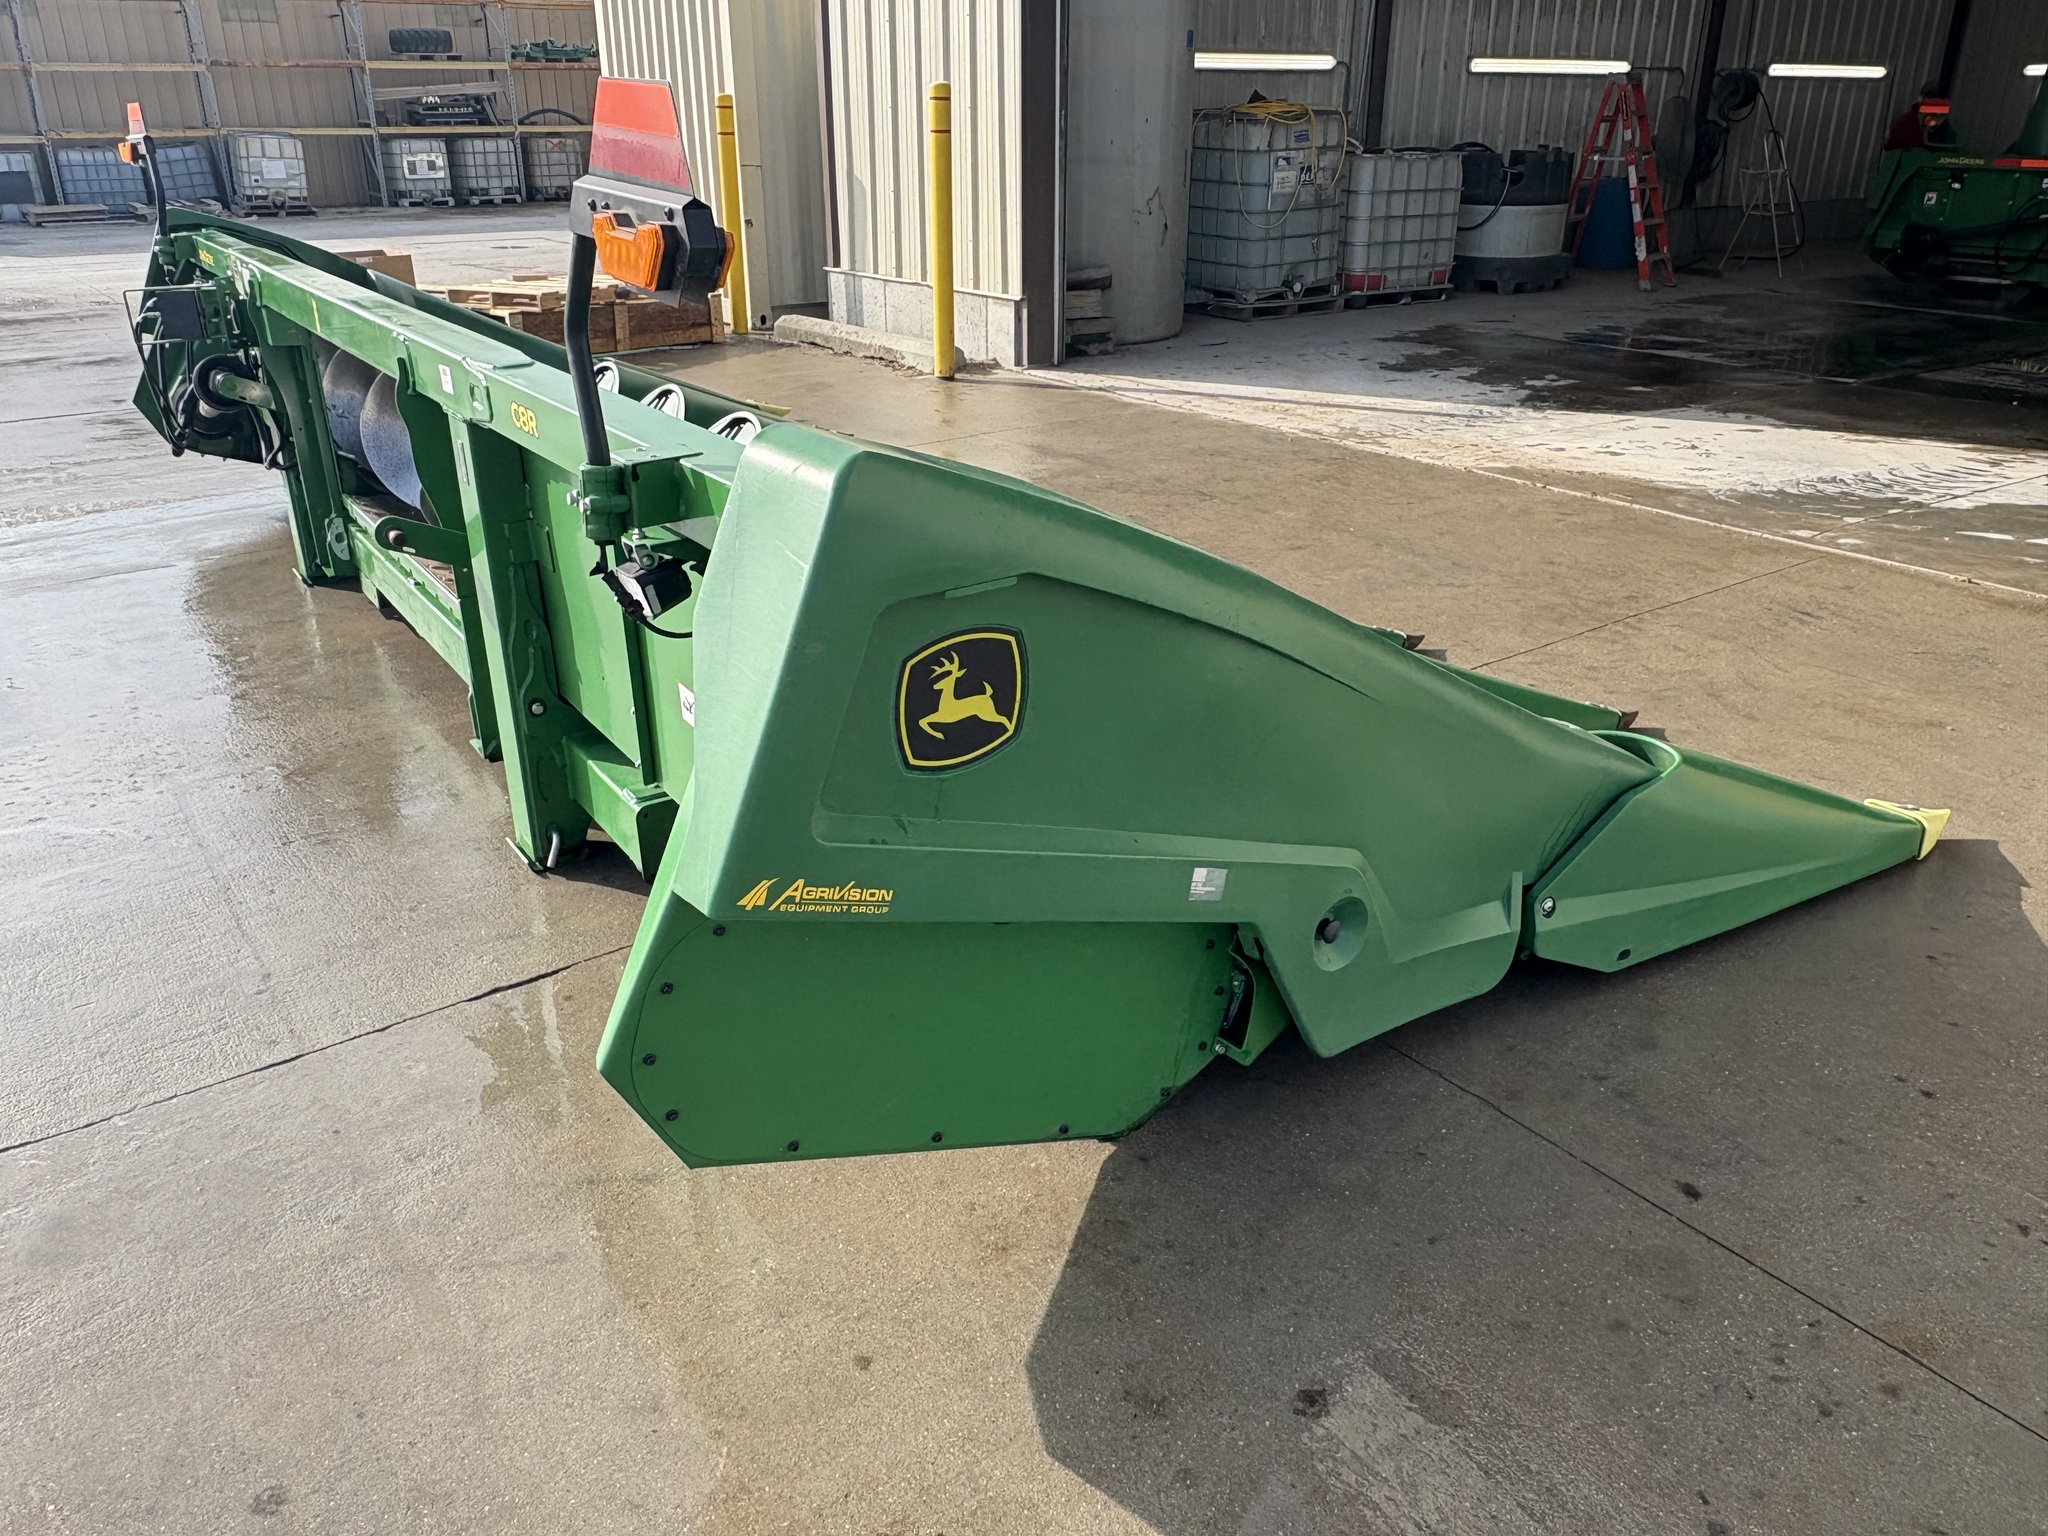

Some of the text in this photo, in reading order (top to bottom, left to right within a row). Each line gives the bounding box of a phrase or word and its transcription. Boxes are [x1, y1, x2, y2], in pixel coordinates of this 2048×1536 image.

[510, 400, 540, 439] C8R
[768, 878, 893, 911] AGRIVISION
[779, 903, 890, 914] EQUIPMENT GROUP
